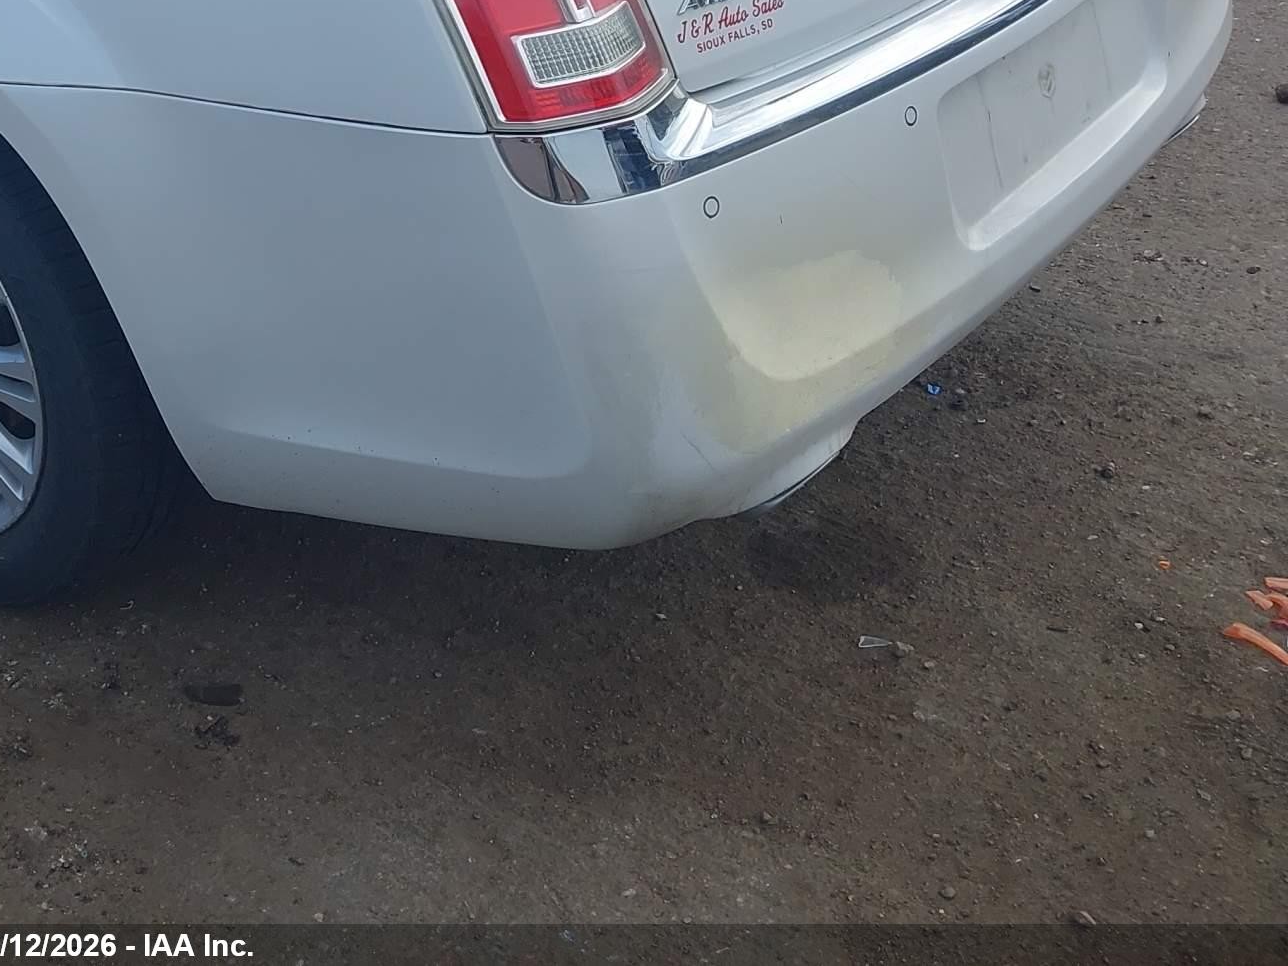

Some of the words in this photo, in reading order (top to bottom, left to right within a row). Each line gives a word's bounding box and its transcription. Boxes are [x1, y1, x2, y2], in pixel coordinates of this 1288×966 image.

[677, 20, 688, 44] J
[691, 19, 701, 38] &
[702, 12, 714, 35] R
[718, 6, 749, 29] Auto
[696, 34, 726, 53] SIOUX
[728, 23, 760, 42] FALLS,
[761, 18, 774, 31] SD
